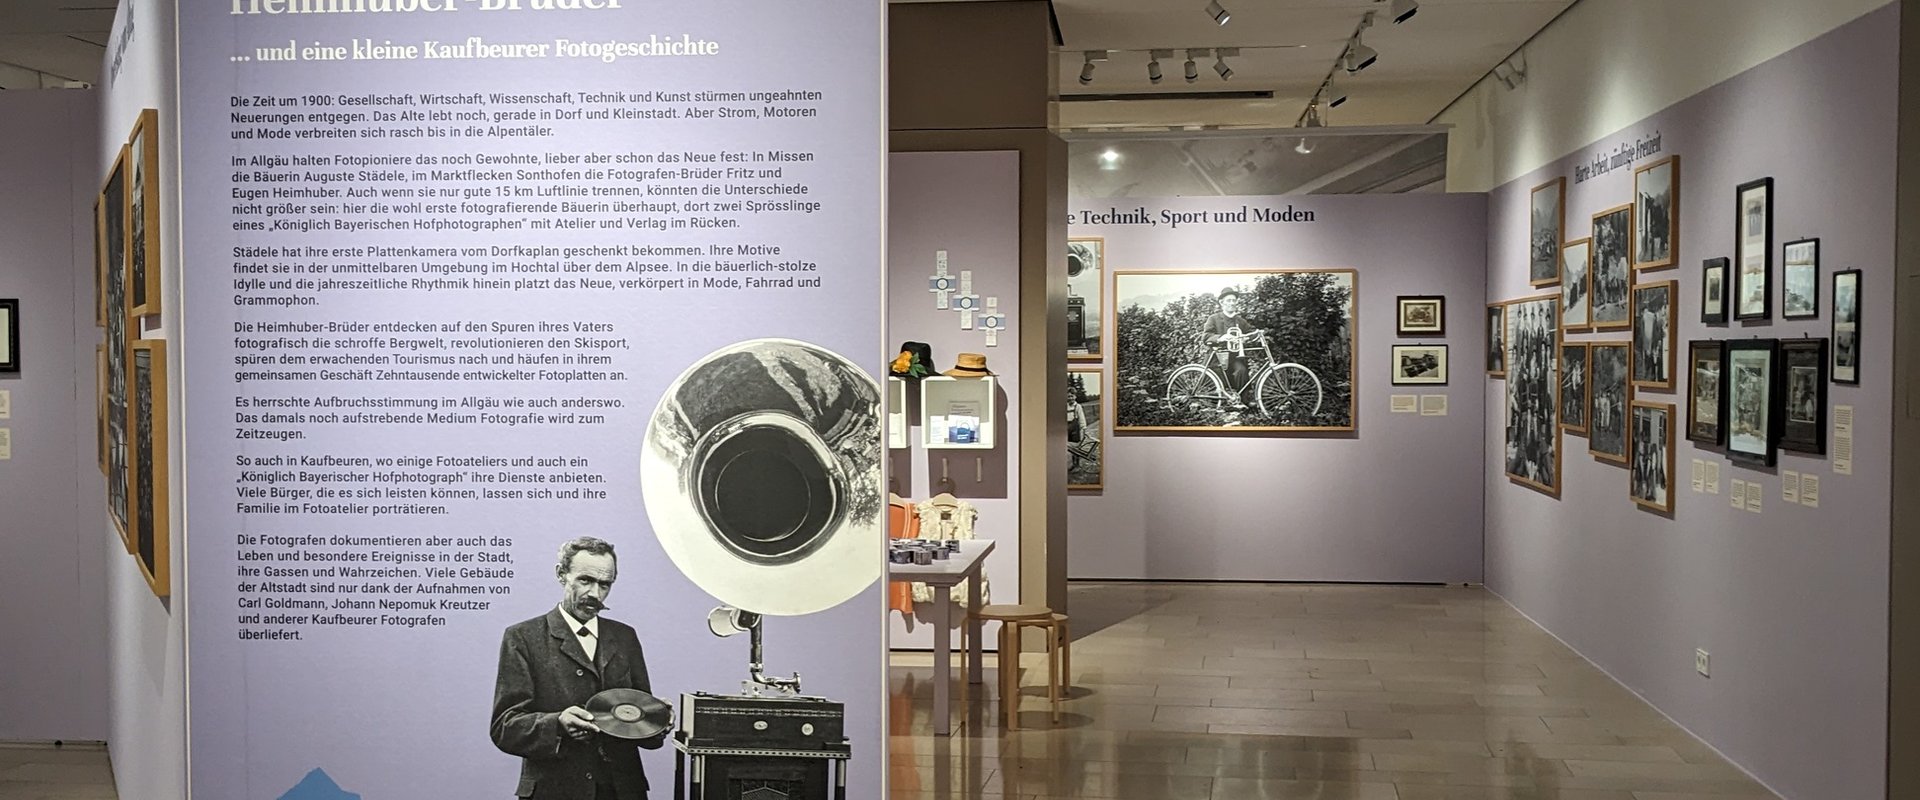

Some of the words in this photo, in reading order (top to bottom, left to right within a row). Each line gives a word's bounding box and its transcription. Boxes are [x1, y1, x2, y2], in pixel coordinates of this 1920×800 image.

[256, 39, 296, 61] und
[301, 41, 347, 60] eine
[352, 38, 418, 60] kleine
[423, 36, 550, 58] Kaufbeurer
[555, 34, 719, 62] Fotogeschichte
[231, 96, 249, 107] Die
[253, 95, 276, 107] Zeit
[279, 97, 297, 107] um
[301, 95, 335, 106] 1900:
[338, 94, 416, 107] Gesellschaft,
[419, 93, 486, 106] Wirtschaft,
[489, 92, 575, 106] Wissenschaft,
[577, 91, 626, 103] Technik
[629, 91, 652, 103] und
[656, 91, 691, 102] Kunst
[694, 90, 745, 102] stürmen
[749, 89, 822, 104] ungeahnten
[231, 112, 304, 125] Neuerungen
[308, 112, 369, 125] entgegen.
[373, 110, 396, 122] Das
[400, 110, 425, 122] Alte
[428, 109, 452, 121] lebt
[456, 109, 489, 123] noch,
[493, 108, 536, 123] gerade
[540, 108, 551, 120] in
[555, 108, 582, 120] Dorf
[586, 108, 609, 119] und
[613, 107, 680, 119] Kleinstadt.
[684, 106, 715, 118] Aber
[718, 106, 759, 120] Strom,
[763, 106, 816, 117] Motoren
[231, 127, 253, 139] und
[257, 127, 291, 139] Mode
[294, 127, 357, 139] verbreiten
[360, 126, 386, 138] sich
[389, 126, 423, 138] rasch
[427, 126, 446, 138] bis
[450, 125, 461, 137] in
[464, 125, 484, 137] die
[487, 125, 554, 139] Alpentäler.
[231, 171, 250, 182] die
[253, 171, 300, 182] Bäuerin
[303, 171, 355, 184] Auguste
[358, 169, 408, 183] Städele,
[412, 170, 427, 181] im
[431, 169, 512, 181] Marktflecken
[516, 168, 581, 180] Sonthofen
[584, 168, 604, 180] die
[607, 167, 723, 182] Fotografen-Brüder
[726, 167, 755, 179] Fritz
[758, 166, 782, 178] und
[1080, 208, 1157, 226] Technik,
[1160, 208, 1208, 228] Sport
[1214, 205, 1247, 223] und
[1253, 205, 1314, 222] Moden
[233, 246, 278, 258] Städele
[282, 246, 301, 258] hat
[305, 246, 328, 257] ihre
[332, 247, 363, 257] erste
[367, 245, 457, 257] Plattenkamera
[461, 248, 487, 257] vom
[491, 245, 559, 259] Dorfkaplan
[563, 244, 628, 259] geschenkt
[632, 244, 705, 256] bekommen.
[709, 244, 733, 256] Ihre
[737, 244, 780, 255] Motive
[234, 294, 319, 308] Grammophon.
[234, 321, 253, 333] Die
[257, 321, 369, 333] Heimhuber-Brüder
[373, 321, 437, 333] entdecken
[441, 321, 461, 333] auf
[464, 321, 487, 333] den
[491, 321, 535, 335] Spuren
[538, 321, 569, 333] ihres
[573, 321, 613, 332] Vaters
[234, 337, 308, 351] fotografisch
[312, 337, 331, 349] die
[334, 336, 386, 348] schroffe
[389, 337, 447, 351] Bergwelt,
[451, 337, 544, 349] revolutionieren
[547, 337, 570, 348] den
[574, 336, 629, 351] Skisport,
[235, 353, 276, 367] spüren
[279, 353, 306, 365] dem
[309, 353, 389, 364] erwachenden
[392, 353, 455, 365] Tourismus
[459, 353, 488, 365] nach
[491, 353, 514, 364] und
[517, 353, 559, 364] häufen
[562, 353, 573, 365] in
[577, 353, 611, 365] ihrem
[235, 369, 317, 383] gemeinsamen
[320, 369, 373, 380] Geschäft
[376, 369, 460, 380] Zehntausende
[463, 369, 536, 381] entwickelter
[539, 369, 606, 383] Fotoplatten
[609, 372, 627, 380] an.
[235, 396, 249, 408] Es
[253, 396, 310, 408] herrschte
[313, 396, 438, 411] Aufbruchsstimmung
[441, 396, 457, 408] im
[460, 396, 499, 411] Allgäu
[503, 396, 524, 408] wie
[528, 396, 557, 408] auch
[561, 396, 624, 408] anderswo.
[236, 412, 258, 423] Das
[261, 412, 305, 423] damals
[309, 412, 338, 423] noch
[342, 411, 423, 424] aufstrebende
[427, 412, 476, 424] Medium
[481, 412, 544, 426] Fotografie
[548, 412, 574, 424] wird
[578, 415, 604, 424] zum
[235, 428, 306, 442] Zeitzeugen.
[237, 534, 256, 545] Die
[260, 534, 326, 548] Fotografen
[329, 534, 422, 546] dokumentieren
[425, 535, 453, 547] aber
[456, 535, 486, 547] auch
[490, 535, 512, 547] das
[238, 549, 274, 561] Leben
[277, 550, 300, 561] und
[303, 550, 368, 562] besondere
[371, 550, 435, 565] Ereignisse
[439, 551, 450, 562] in
[453, 551, 474, 562] der
[477, 551, 513, 564] Stadt,
[238, 565, 260, 577] ihre
[264, 566, 309, 577] Gassen
[312, 566, 335, 577] und
[338, 566, 421, 578] Wahrzeichen.
[425, 566, 456, 578] Viele
[459, 567, 514, 579] Gebäude
[238, 597, 261, 608] Carl
[264, 597, 328, 611] Goldmann,
[331, 597, 375, 609] Johann
[379, 598, 437, 612] Nepomuk
[439, 599, 490, 610] Kreutzer
[238, 613, 260, 624] und
[263, 613, 308, 625] anderer
[312, 613, 378, 625] Kaufbeurer
[381, 614, 445, 628] Fotografen
[238, 628, 302, 640] überliefert.
